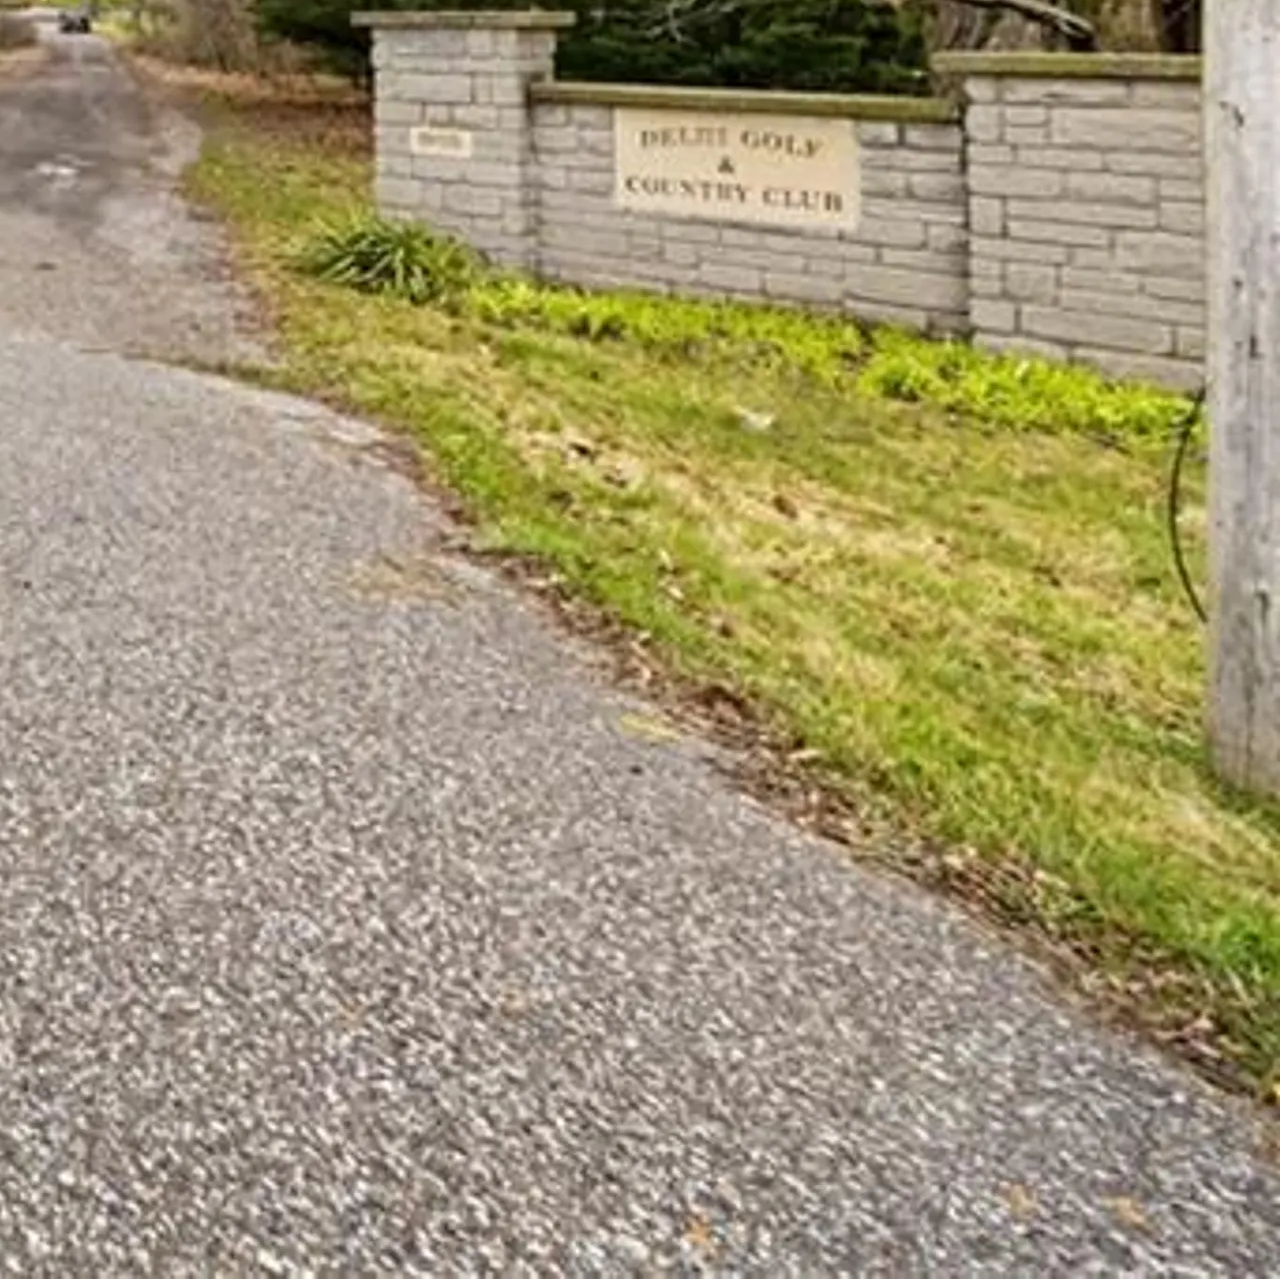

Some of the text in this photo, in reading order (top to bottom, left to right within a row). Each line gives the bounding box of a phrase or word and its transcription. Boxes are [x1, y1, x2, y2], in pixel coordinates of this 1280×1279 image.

[639, 125, 824, 159] DELHI GOLF
[716, 155, 736, 175] &
[624, 174, 844, 213] COUNTRY CLUB
